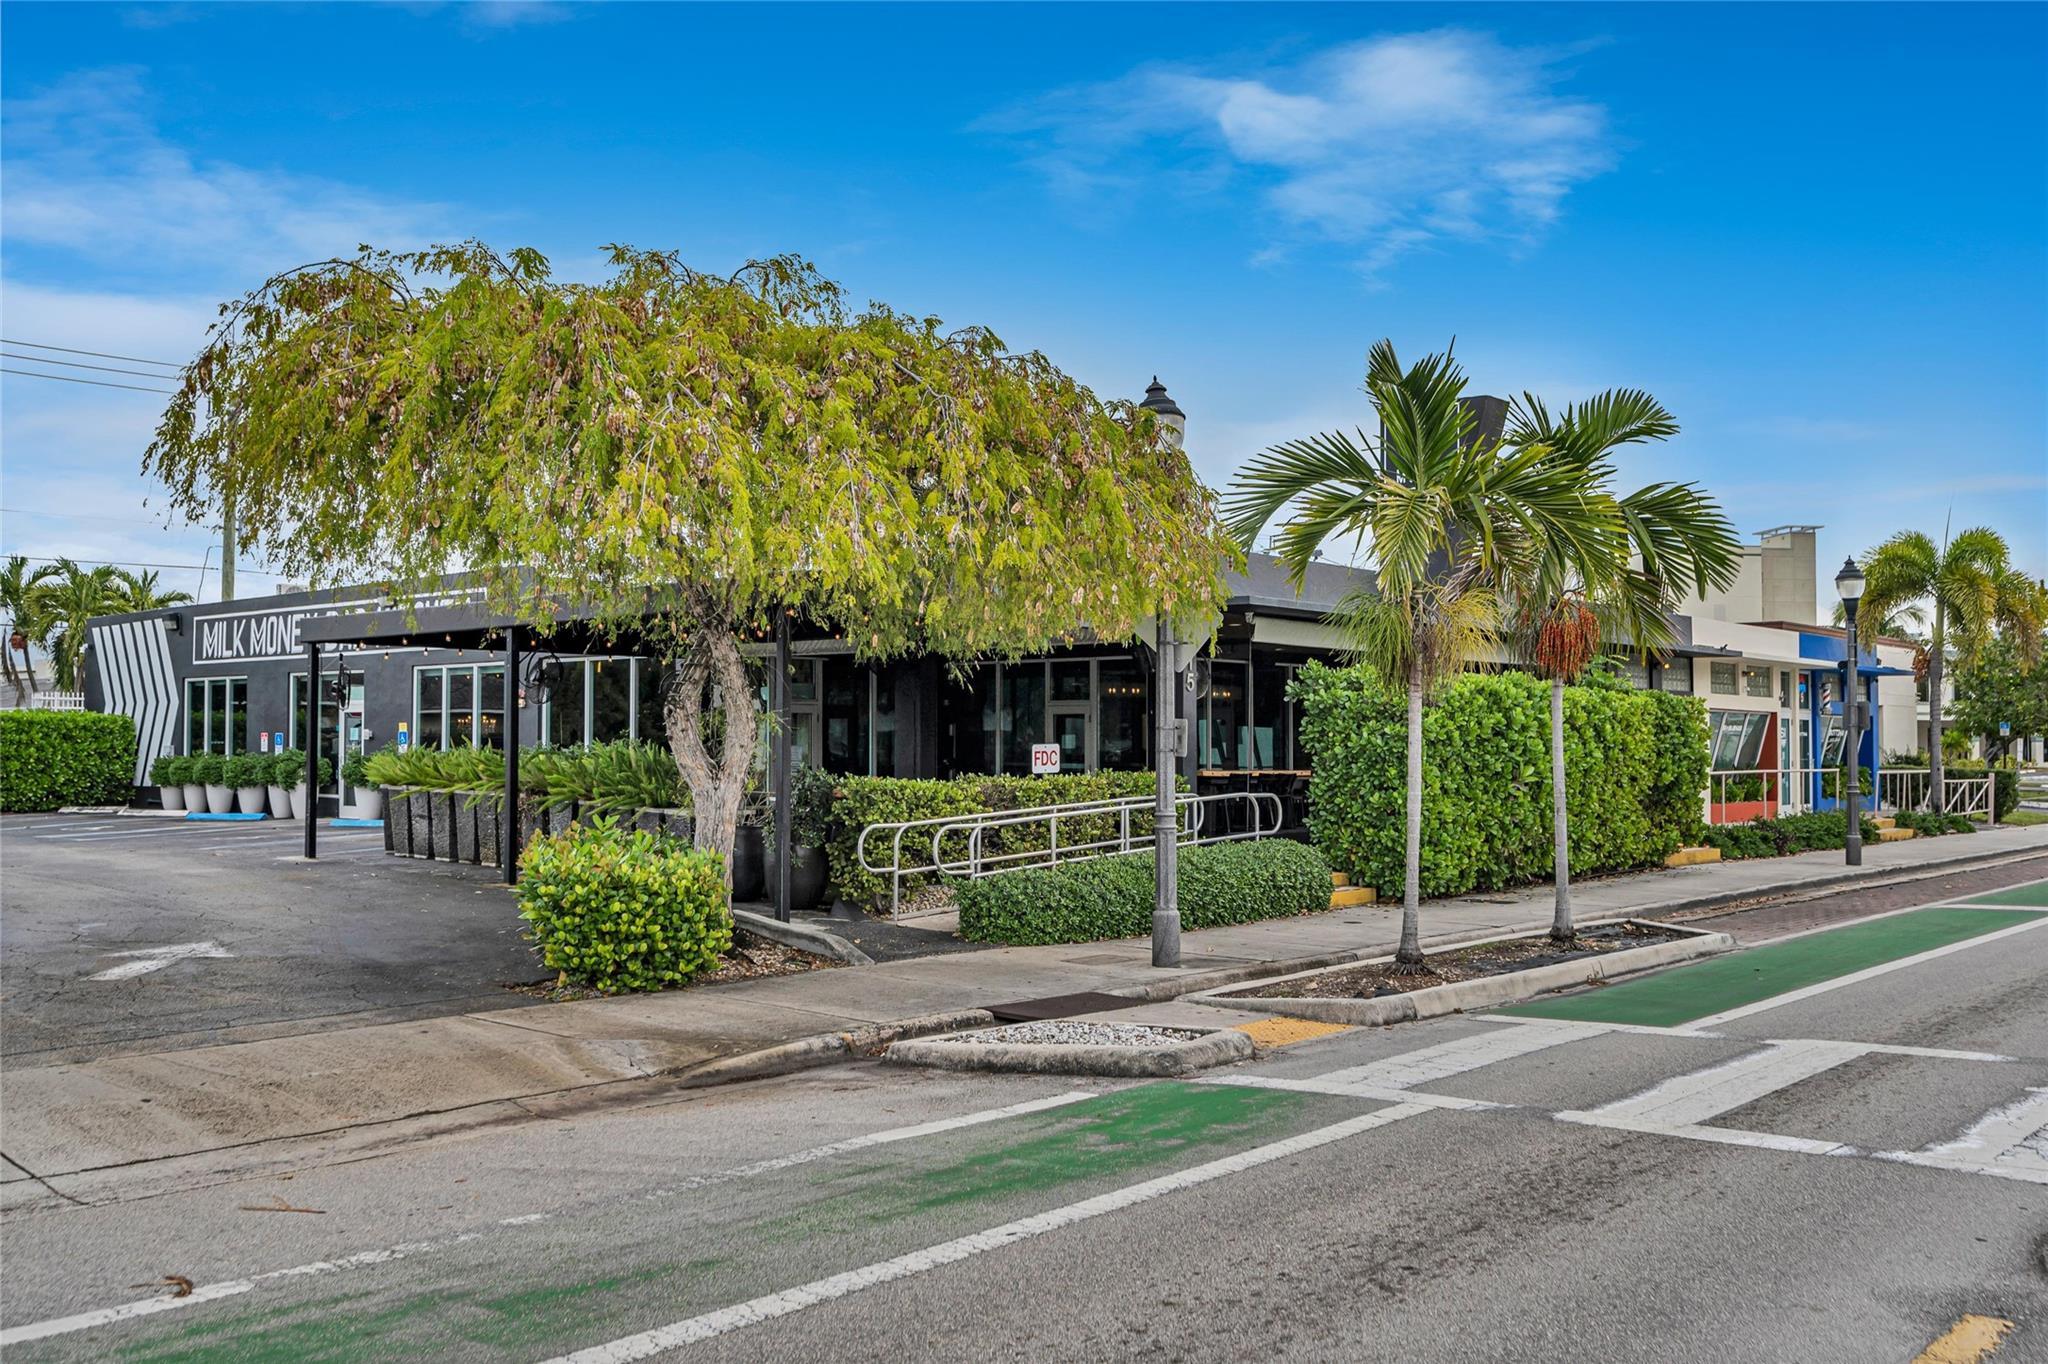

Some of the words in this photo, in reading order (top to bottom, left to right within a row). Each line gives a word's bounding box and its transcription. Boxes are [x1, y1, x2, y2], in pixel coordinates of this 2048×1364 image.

[202, 619, 246, 659] MILK
[250, 612, 319, 656] MONE
[1034, 750, 1058, 767] FDC
